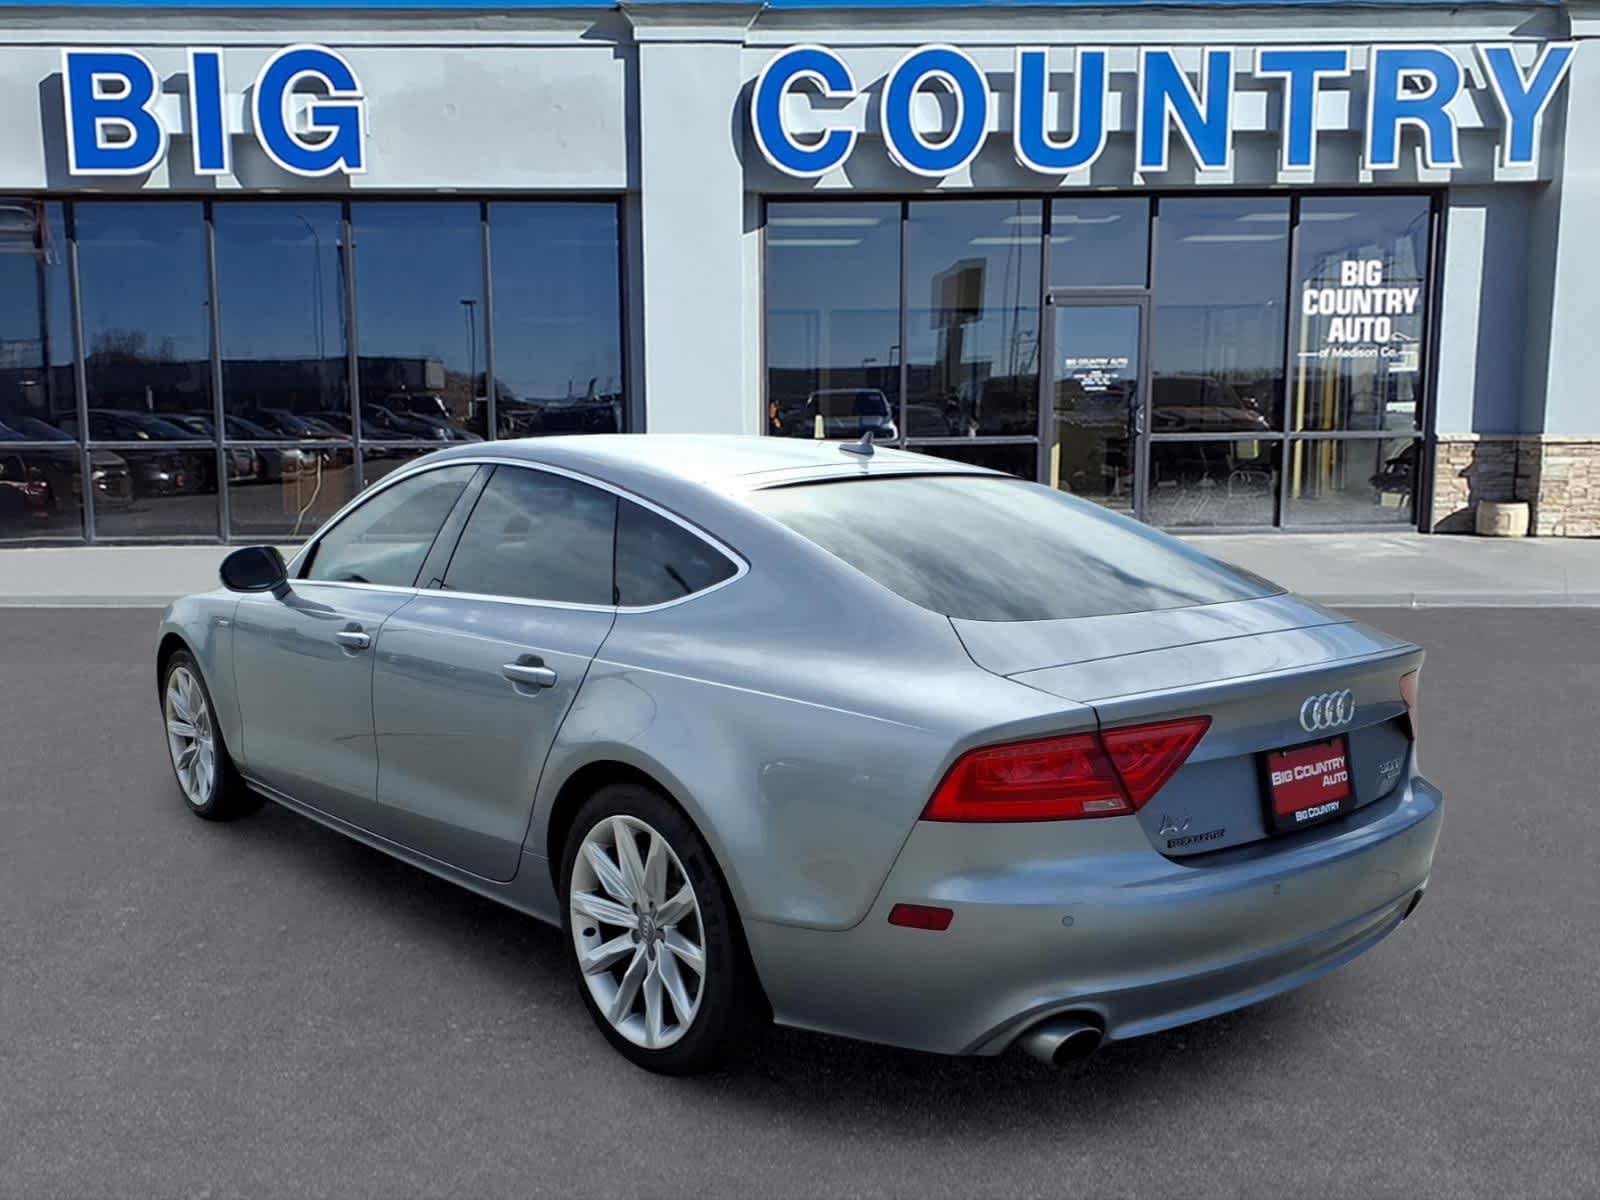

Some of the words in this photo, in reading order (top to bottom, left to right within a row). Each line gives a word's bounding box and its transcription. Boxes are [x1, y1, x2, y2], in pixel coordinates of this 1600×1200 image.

[62, 43, 367, 177] BIG
[750, 43, 1577, 178] COUNTRY
[1341, 260, 1382, 286] BIG
[1303, 288, 1419, 315] COUNTRY
[1328, 317, 1391, 342] AUTO
[1272, 771, 1293, 786] BIG
[1294, 756, 1345, 780] COUNTRY
[1322, 771, 1348, 787] AUTO
